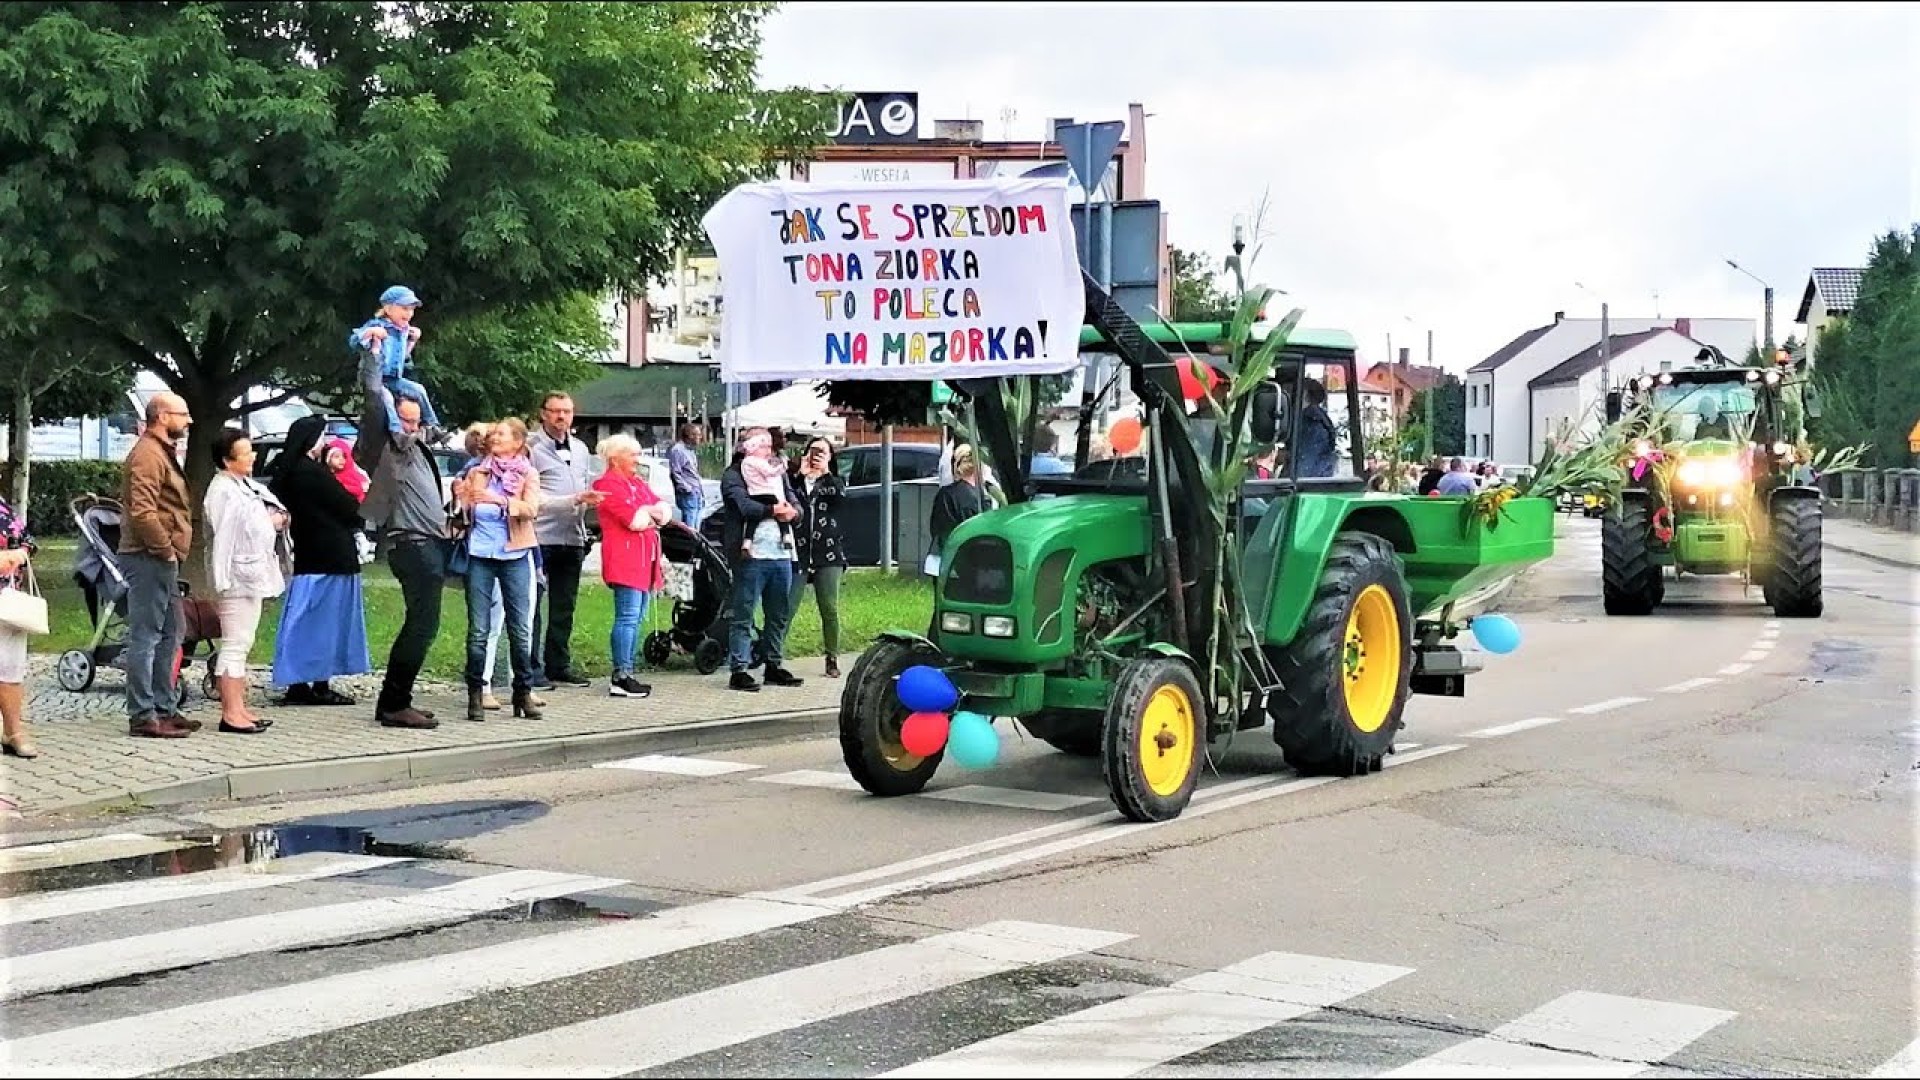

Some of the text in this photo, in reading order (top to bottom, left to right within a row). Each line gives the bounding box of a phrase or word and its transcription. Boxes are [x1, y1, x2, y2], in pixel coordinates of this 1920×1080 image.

[771, 202, 1047, 245] JAK SE SPRZEDOM
[783, 248, 979, 284] TONA ZIORKA
[816, 287, 981, 321] TO POLECA
[825, 320, 1048, 365] NA MAJORKA!
